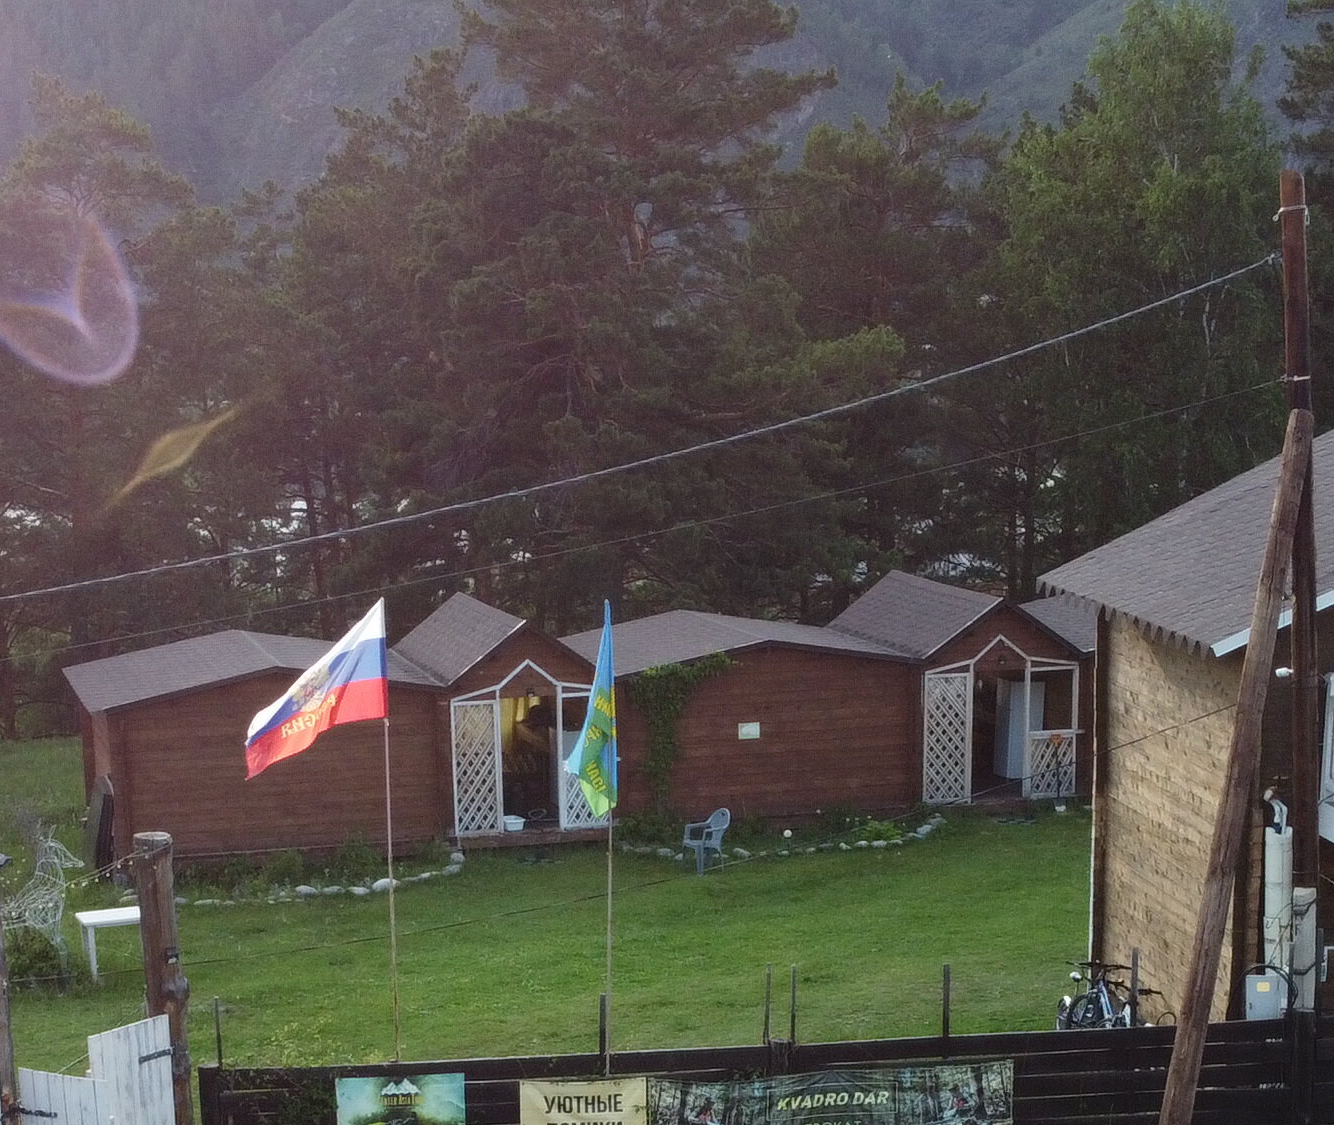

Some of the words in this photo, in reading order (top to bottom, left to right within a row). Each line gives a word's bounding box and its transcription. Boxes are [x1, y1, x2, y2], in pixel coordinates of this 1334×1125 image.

[543, 1094, 623, 1114] УЮТНЫЕ
[777, 1092, 848, 1110] KVADRO
[852, 1091, 889, 1104] DAR
